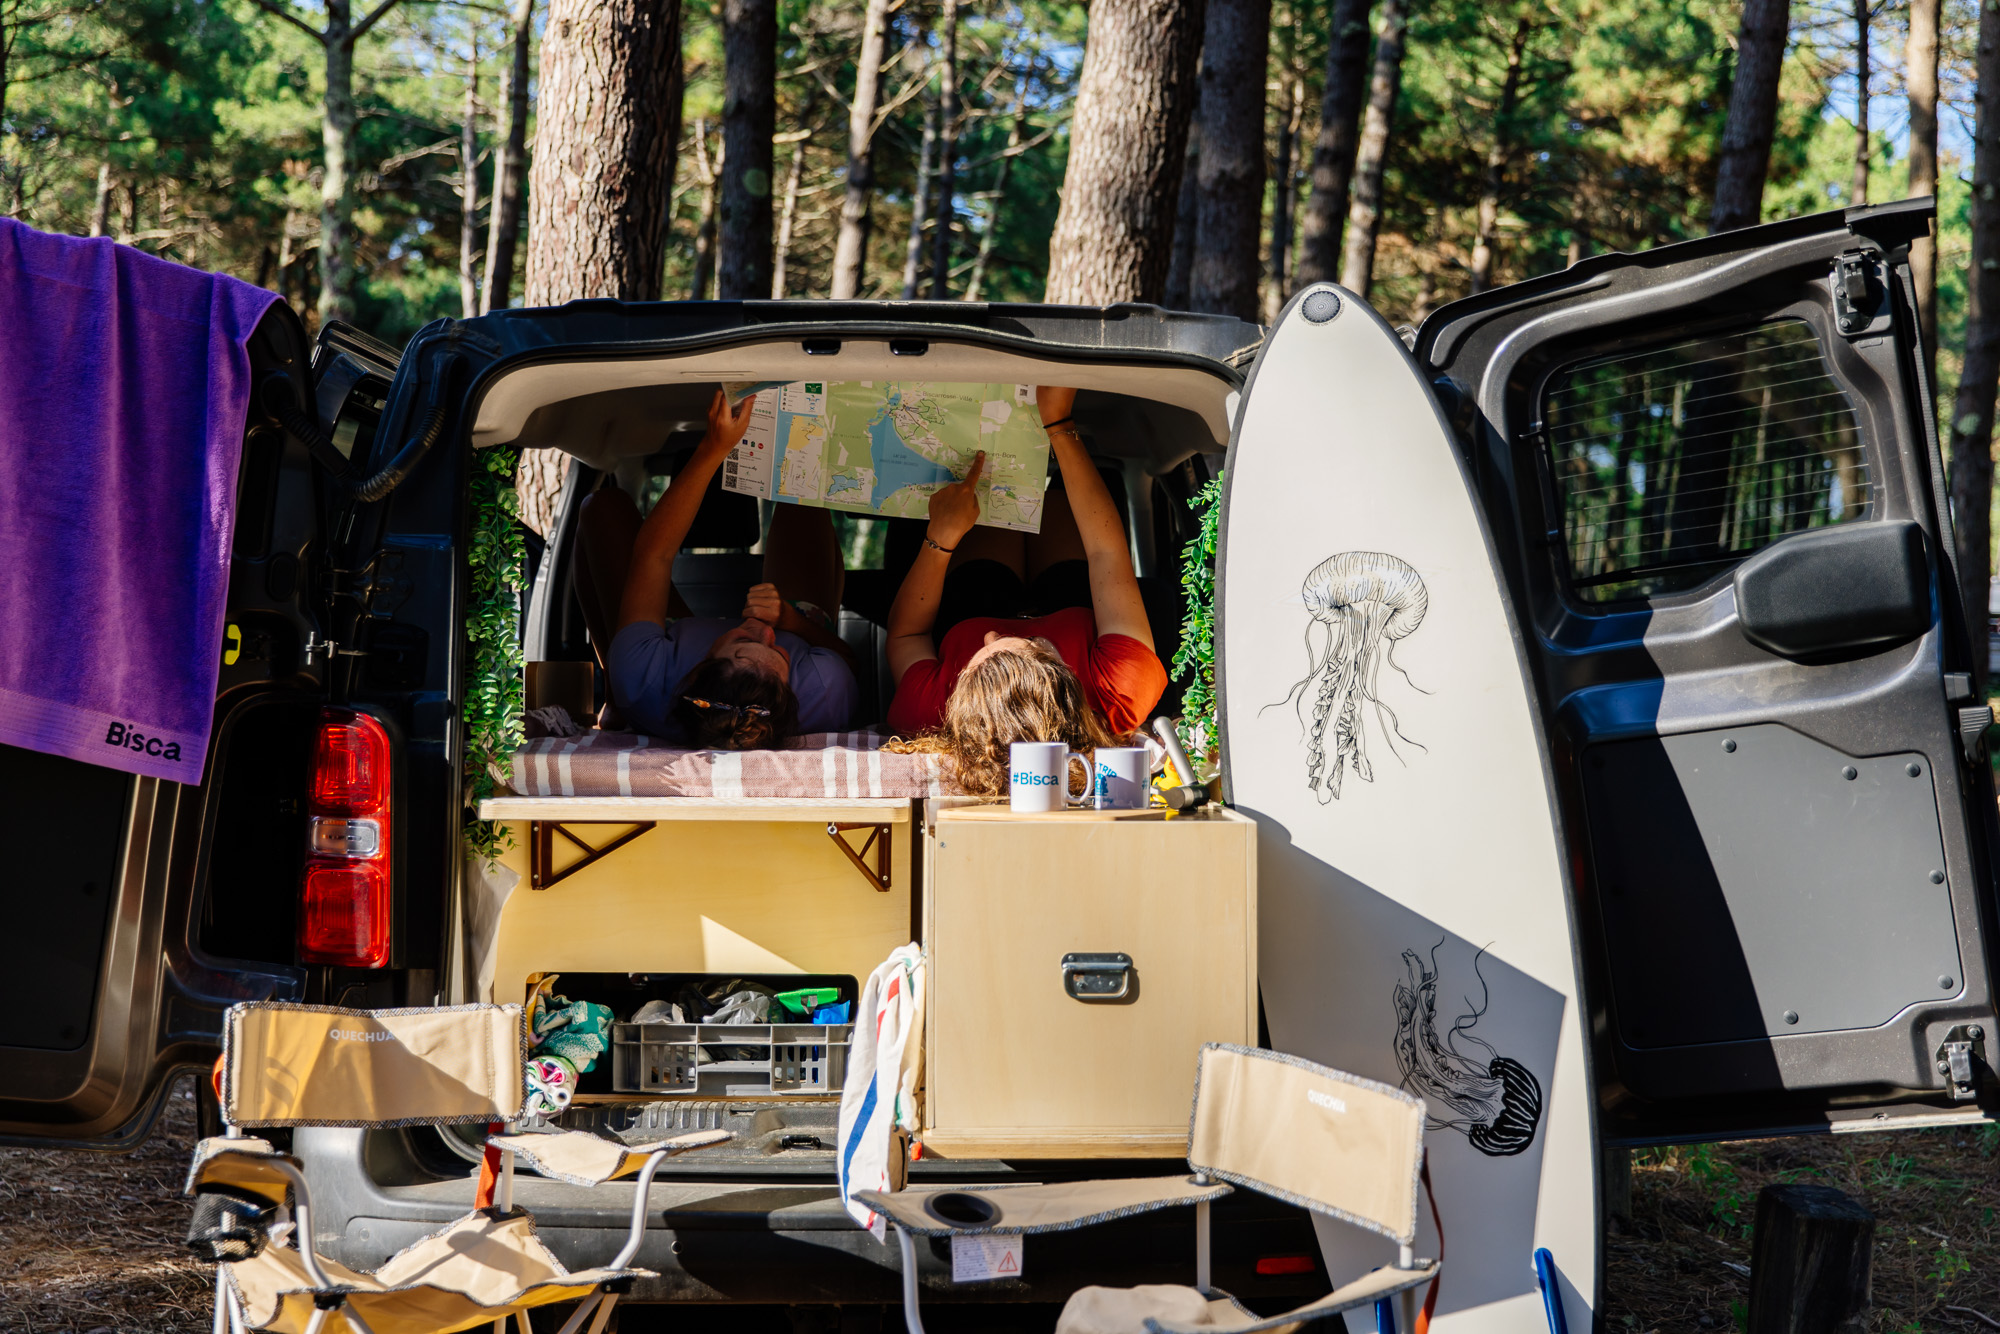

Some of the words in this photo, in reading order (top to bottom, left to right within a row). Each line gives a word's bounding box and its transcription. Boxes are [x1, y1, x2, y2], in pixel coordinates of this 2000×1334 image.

[922, 391, 973, 402] Biscarrosse-Ville
[105, 721, 181, 762] Bisca
[1099, 763, 1117, 778] TRIP
[1013, 771, 1059, 786] #Bisca
[330, 1029, 395, 1042] QUECHUA
